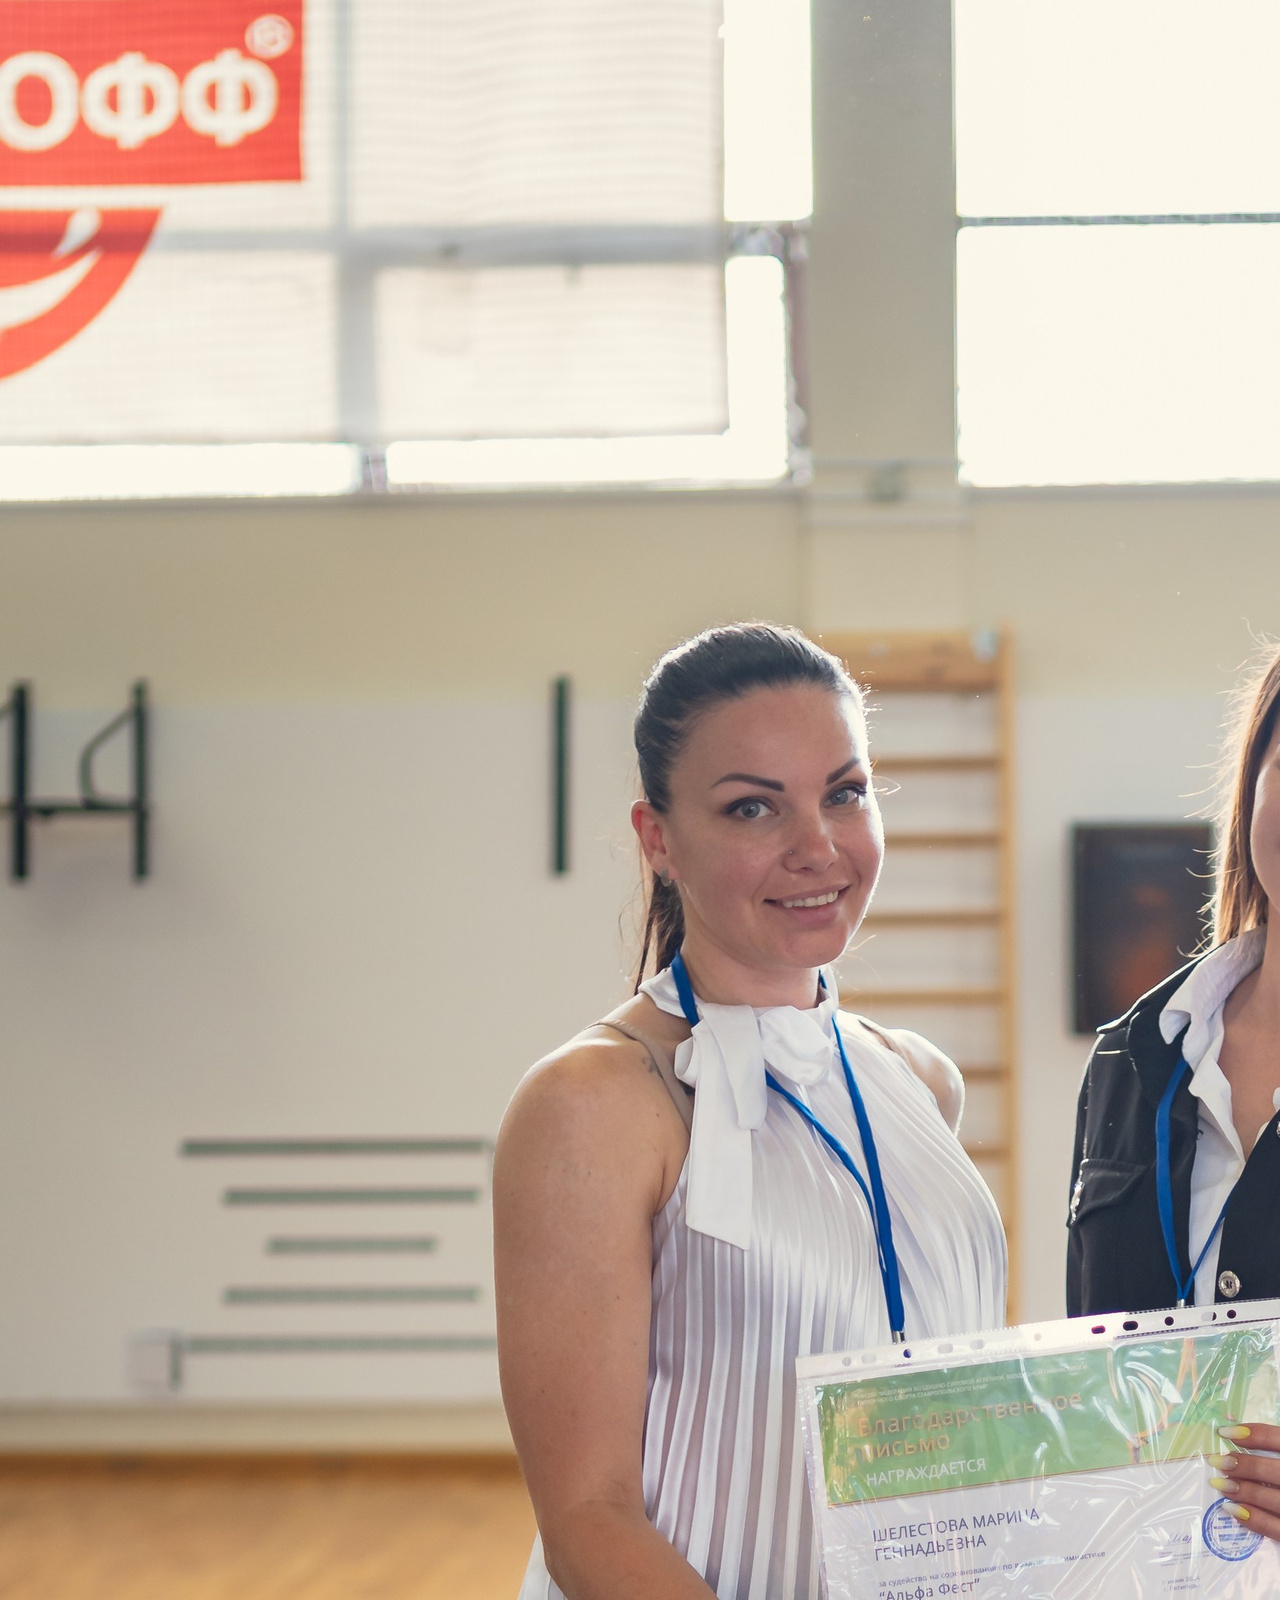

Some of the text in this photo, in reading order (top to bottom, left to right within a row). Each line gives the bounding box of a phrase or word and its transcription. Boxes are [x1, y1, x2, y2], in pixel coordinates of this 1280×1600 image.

[858, 1392, 1083, 1438] Благодарственое
[861, 1434, 951, 1463] письмо
[867, 1457, 987, 1487] НАГРАЖДАЕТСЯ
[873, 1517, 969, 1543] ШЕЛЕСТОВА
[888, 1575, 928, 1588] судейство
[1002, 1563, 1014, 1571] по
